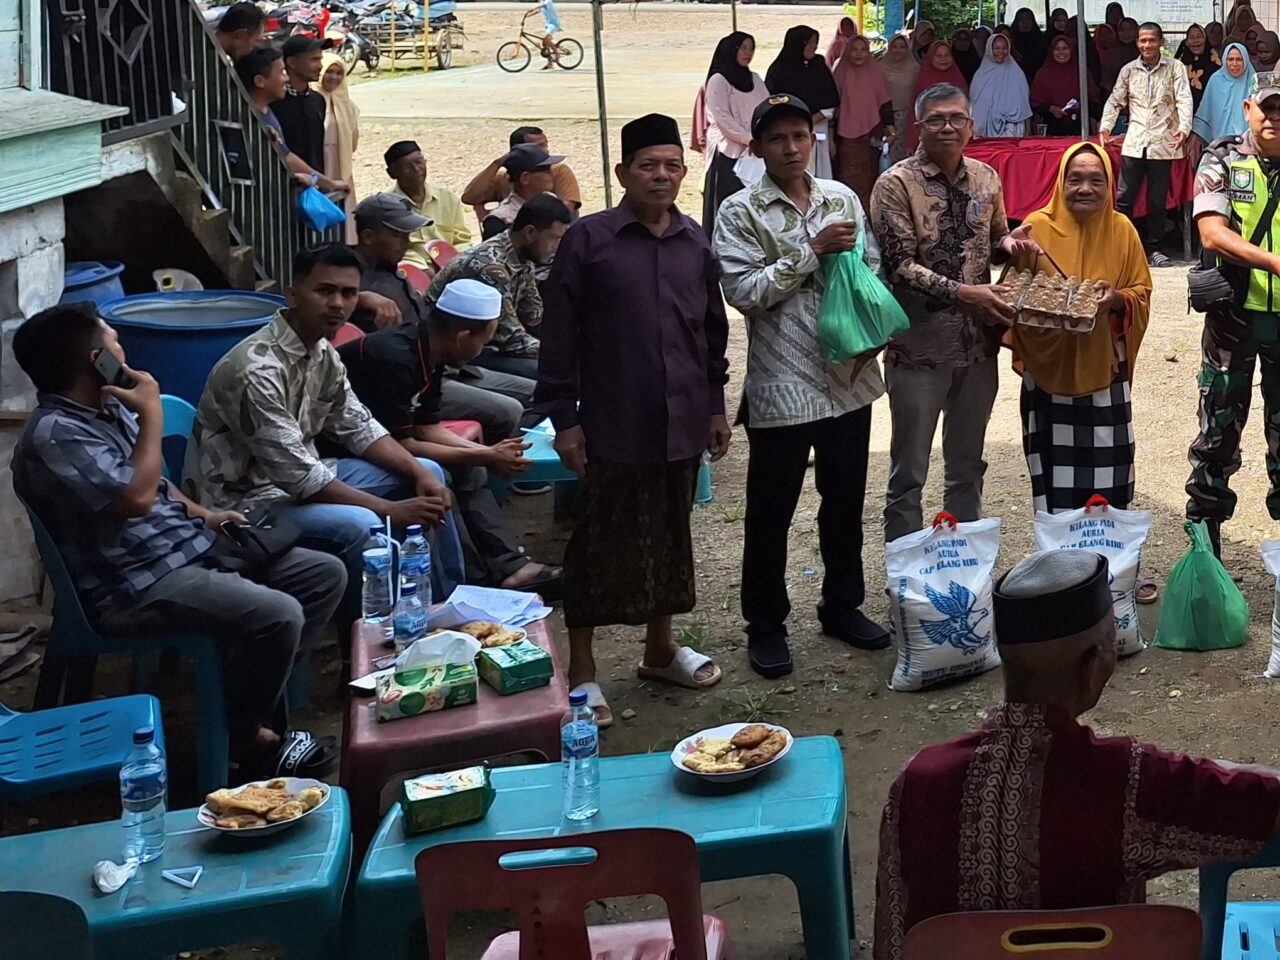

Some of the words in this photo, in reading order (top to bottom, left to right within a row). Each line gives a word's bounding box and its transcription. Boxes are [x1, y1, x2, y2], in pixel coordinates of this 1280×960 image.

[1070, 519, 1098, 532] KILANG
[1078, 538, 1103, 549] ELANG
[919, 566, 935, 576] CAP
[937, 560, 961, 571] ELANG
[572, 734, 595, 747] AQUA
